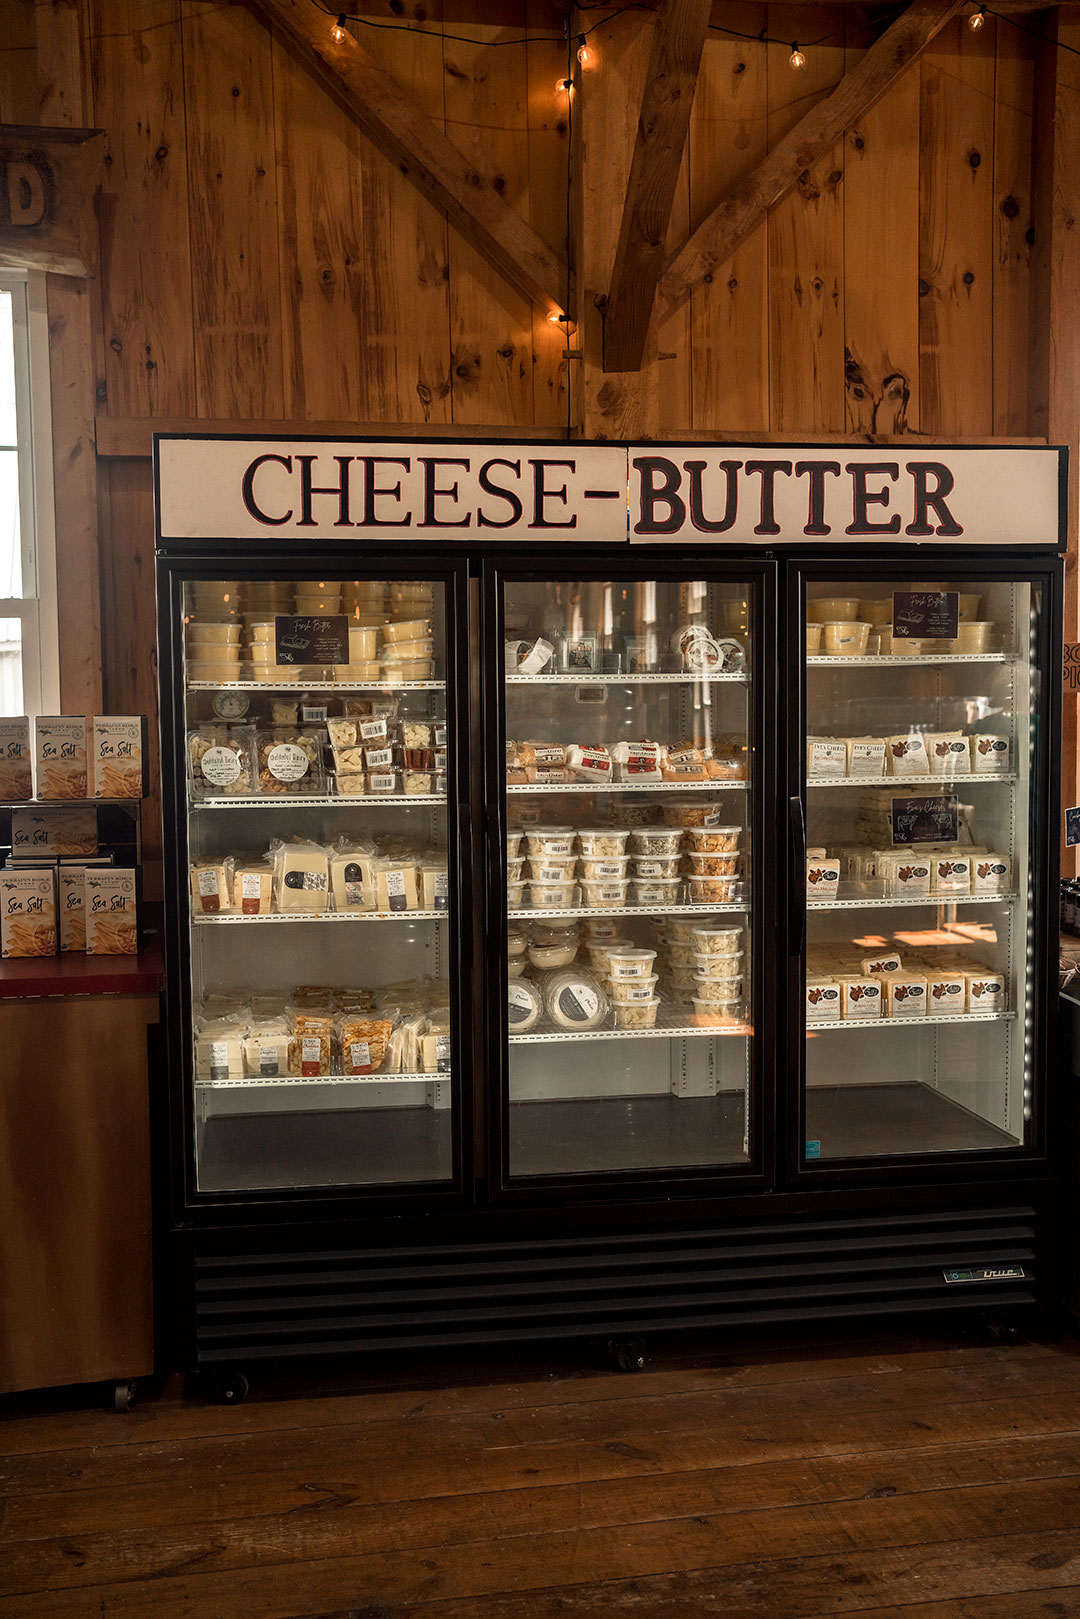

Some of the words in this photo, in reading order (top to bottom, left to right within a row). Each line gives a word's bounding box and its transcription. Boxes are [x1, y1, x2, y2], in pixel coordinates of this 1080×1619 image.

[7, 742, 26, 758] Salt
[42, 742, 57, 758] Sea
[60, 742, 81, 758] Salt
[100, 741, 114, 757] Sea
[117, 741, 136, 757] Salt
[14, 829, 29, 845] Sea
[33, 829, 54, 845] Salt
[8, 896, 23, 913] Sea
[27, 896, 48, 913] Salt
[66, 892, 82, 909] Sea
[92, 894, 107, 911] Sea
[110, 894, 131, 911] Salt
